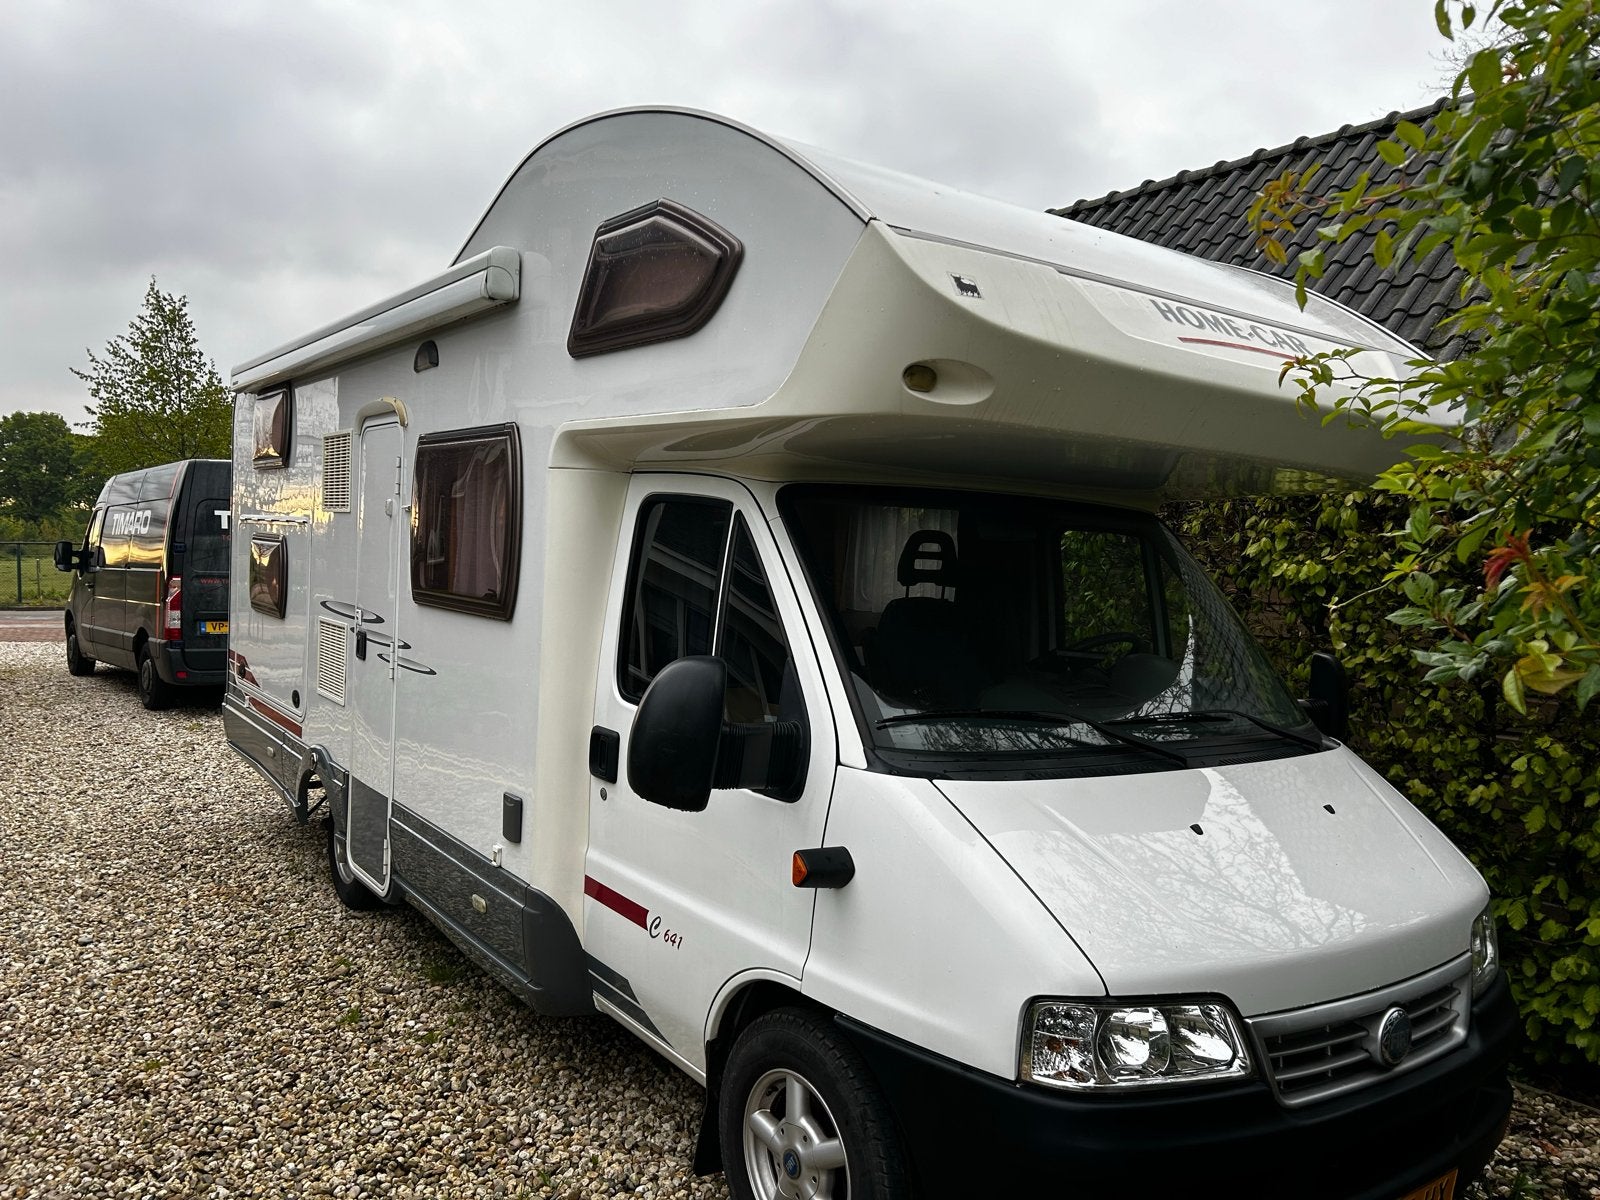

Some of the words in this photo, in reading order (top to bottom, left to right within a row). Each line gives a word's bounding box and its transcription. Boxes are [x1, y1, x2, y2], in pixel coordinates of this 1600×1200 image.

[1150, 299, 1314, 356] HOME-CAR
[112, 509, 152, 536] TIMARO
[649, 916, 662, 939] C
[664, 929, 682, 950] 641
